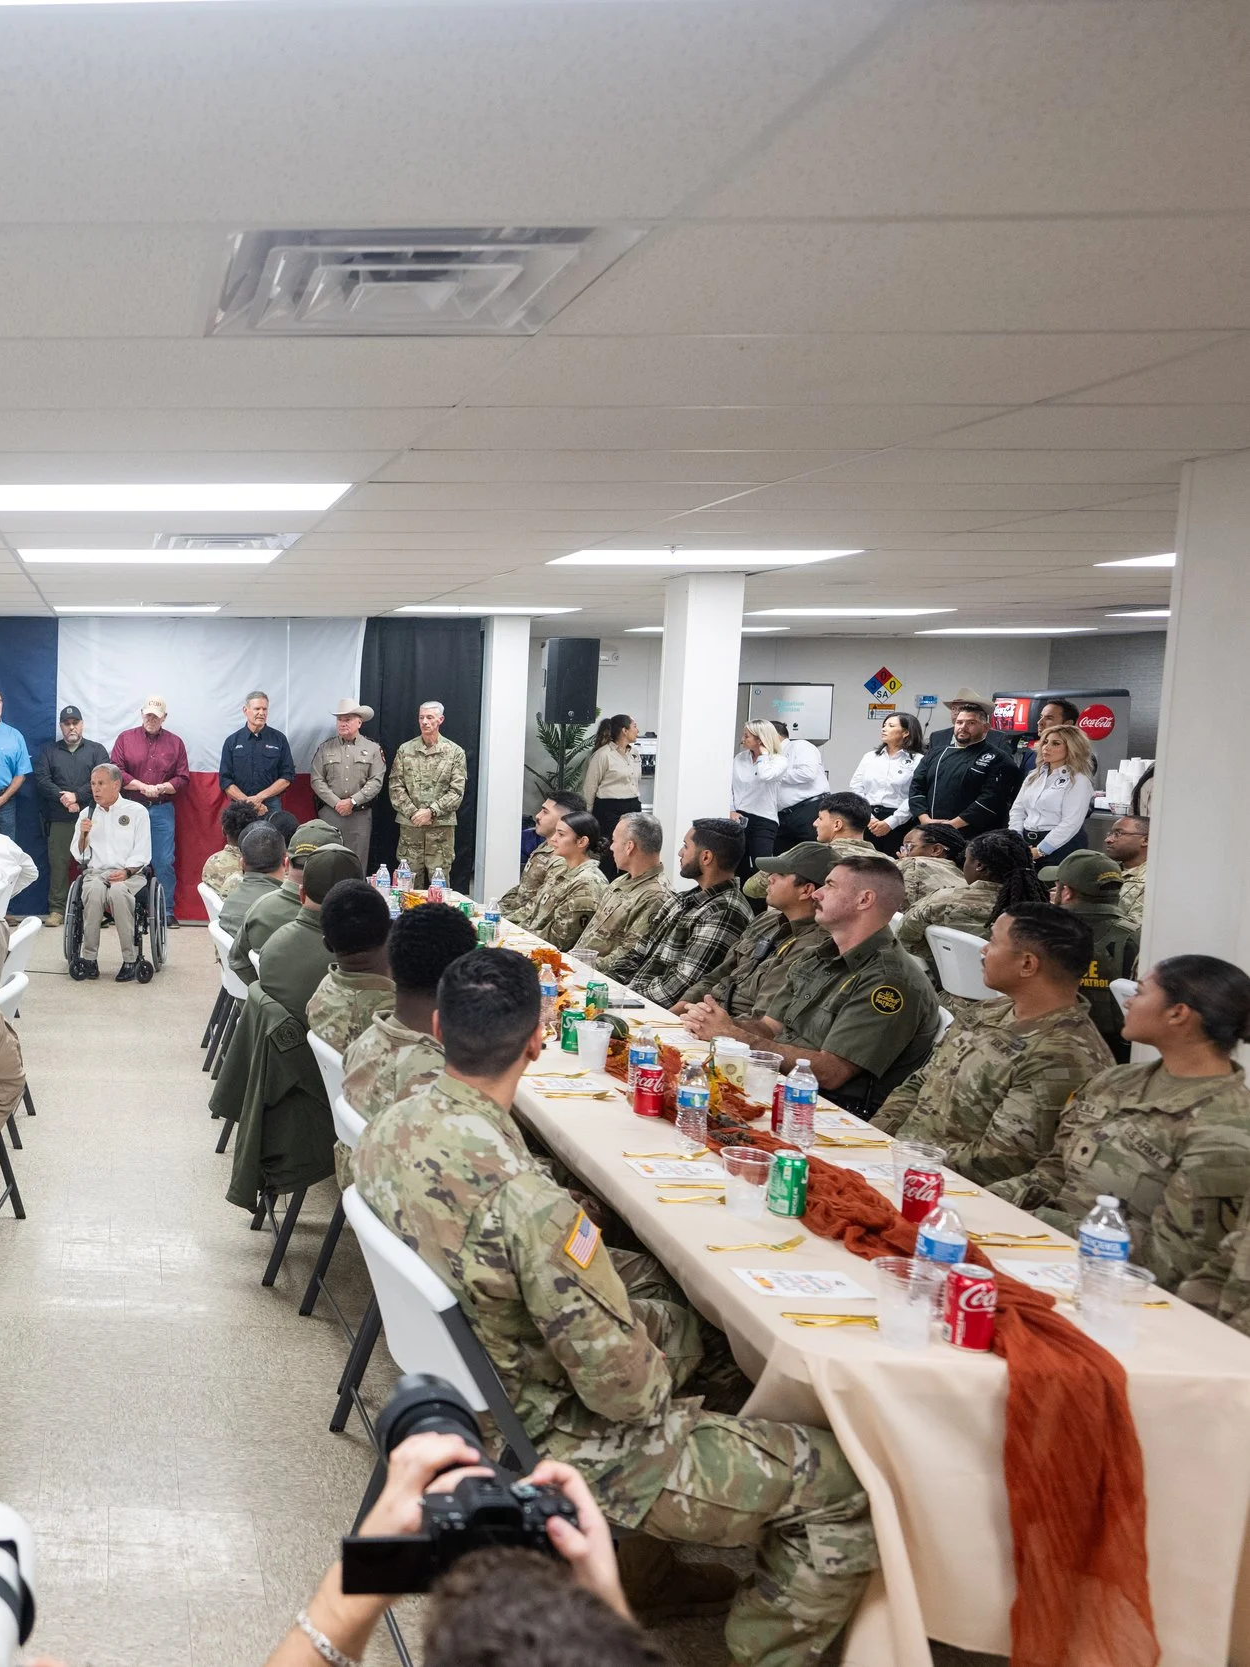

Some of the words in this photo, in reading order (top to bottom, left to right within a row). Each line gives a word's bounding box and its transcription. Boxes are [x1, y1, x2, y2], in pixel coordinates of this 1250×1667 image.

[880, 672, 887, 681] 0
[889, 680, 896, 690] 0
[876, 690, 889, 699] SA
[1079, 716, 1114, 729] Coca-Cola
[1137, 1138, 1164, 1161] ARMY
